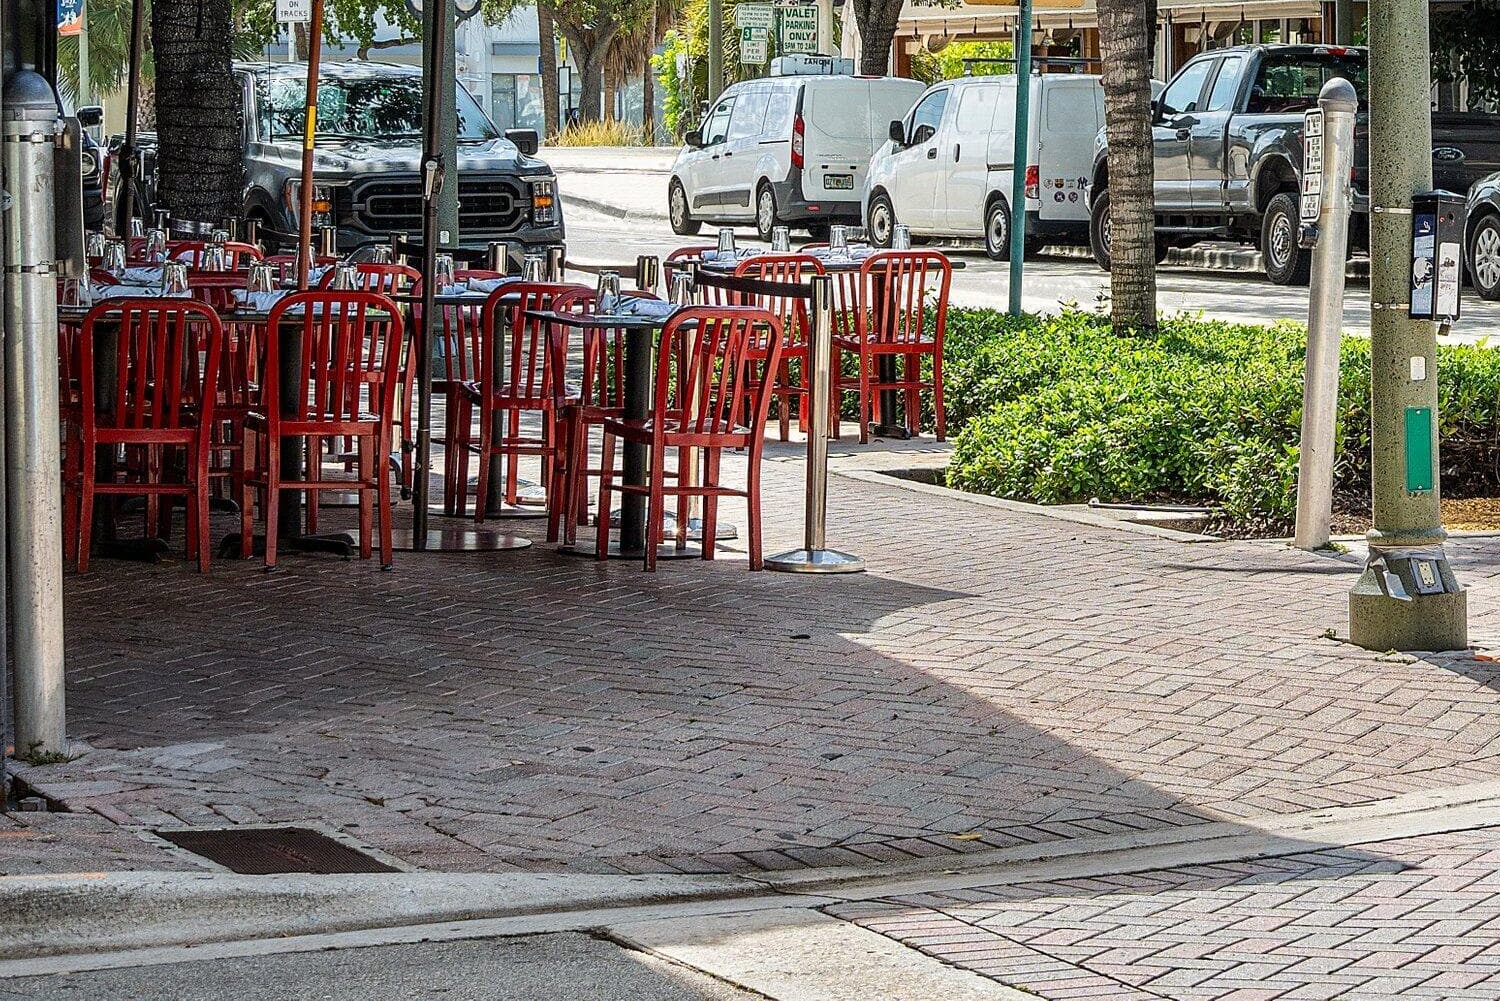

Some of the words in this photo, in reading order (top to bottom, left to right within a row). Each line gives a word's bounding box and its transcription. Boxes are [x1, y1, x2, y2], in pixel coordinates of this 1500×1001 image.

[289, 0, 299, 8] ON
[279, 10, 308, 18] TRACKS
[785, 8, 816, 18] VALET
[785, 21, 815, 30] PARKING
[744, 29, 750, 39] 3
[789, 32, 811, 41] ONLY
[785, 42, 796, 50] 5PM
[797, 42, 804, 50] TO
